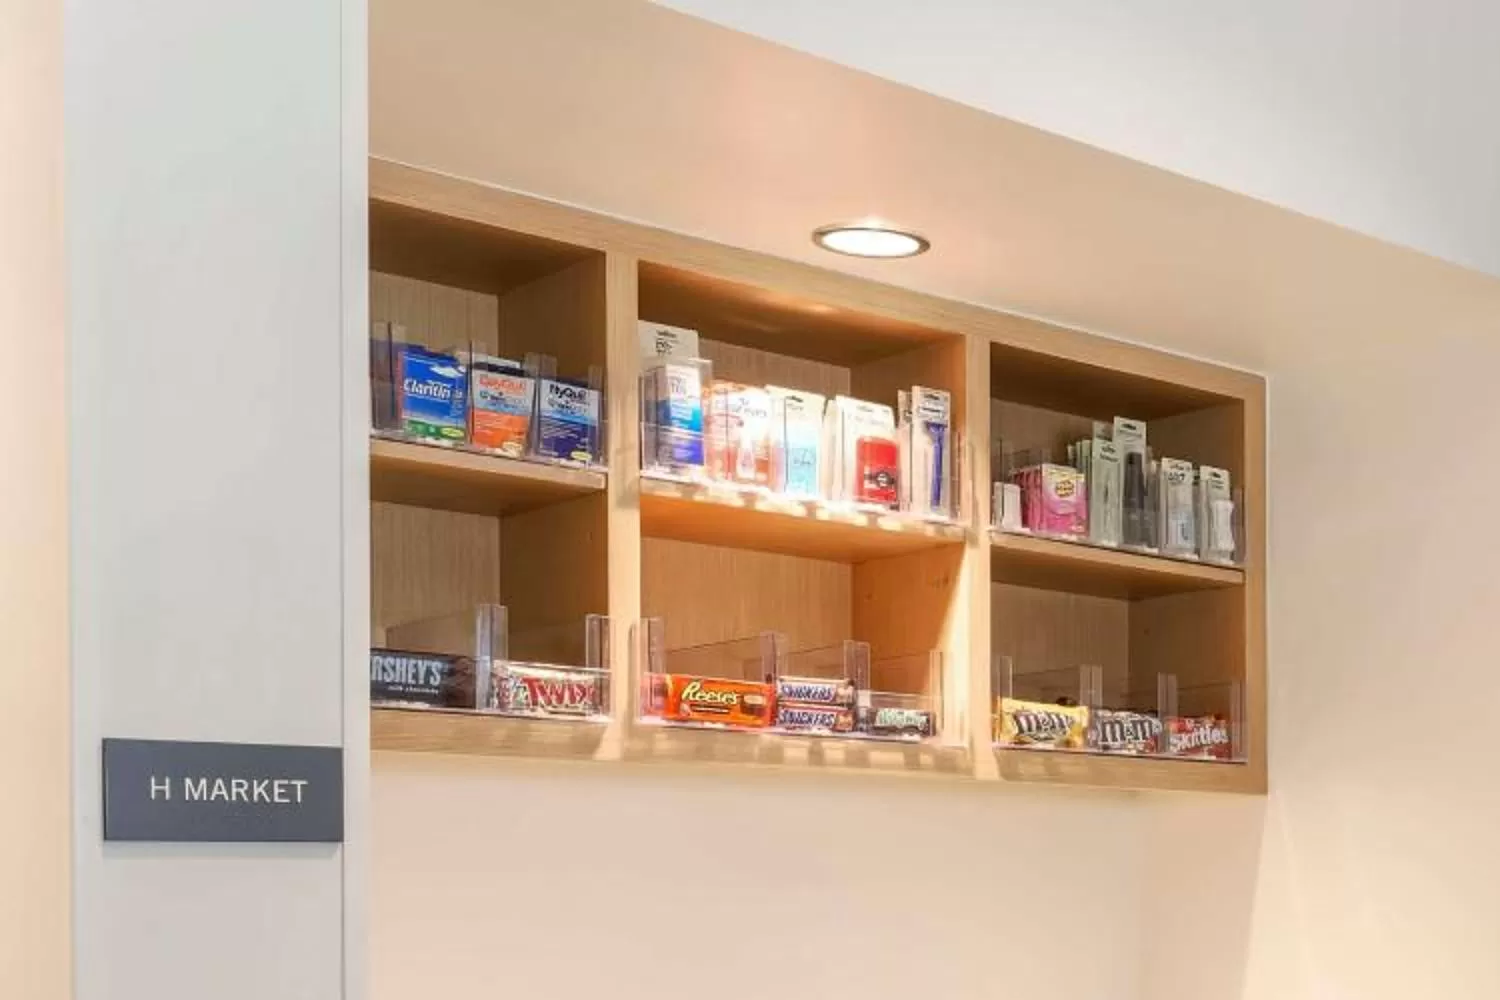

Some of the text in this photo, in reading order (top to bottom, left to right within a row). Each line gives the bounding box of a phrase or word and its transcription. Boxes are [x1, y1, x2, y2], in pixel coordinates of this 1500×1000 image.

[369, 655, 442, 686] RSHEY'S
[780, 683, 836, 702] SNICKERS
[779, 711, 835, 728] SNICKERS
[1168, 725, 1230, 752] Skittles
[149, 775, 309, 803] H MARKET
